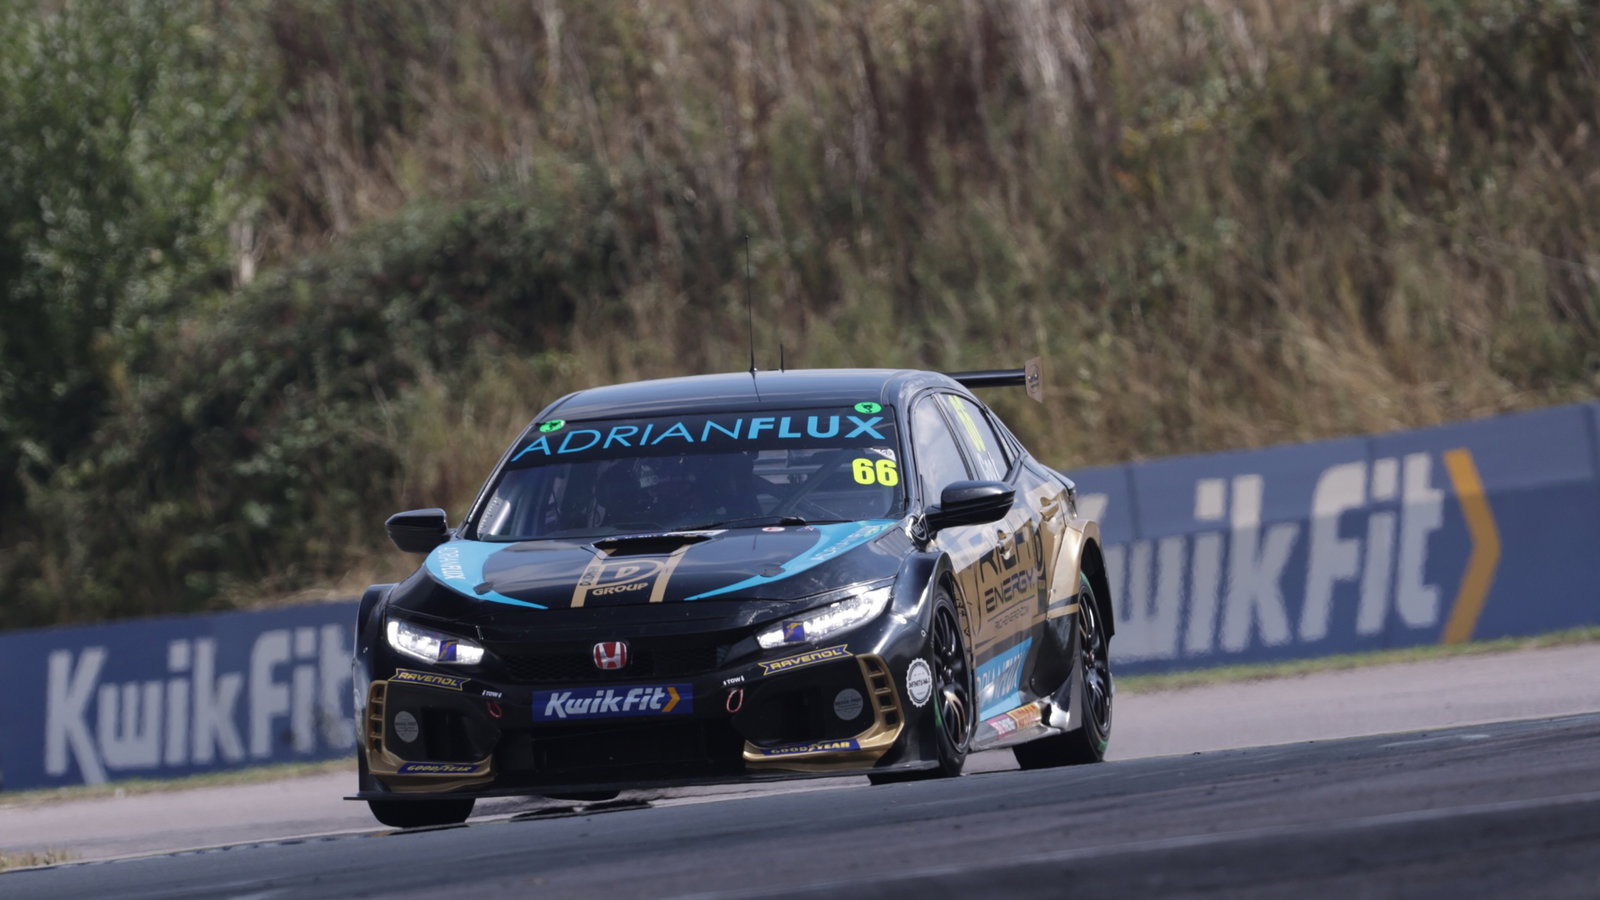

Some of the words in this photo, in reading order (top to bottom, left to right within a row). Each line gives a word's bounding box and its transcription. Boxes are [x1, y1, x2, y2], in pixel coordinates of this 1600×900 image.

[510, 415, 886, 462] ADRIANFLUX
[852, 457, 899, 487] 66
[1074, 452, 1444, 666] wikFit
[592, 582, 649, 596] GROUP
[769, 649, 843, 670] RAVENOL
[398, 671, 458, 687] RAVENOL
[726, 676, 741, 685] TOW
